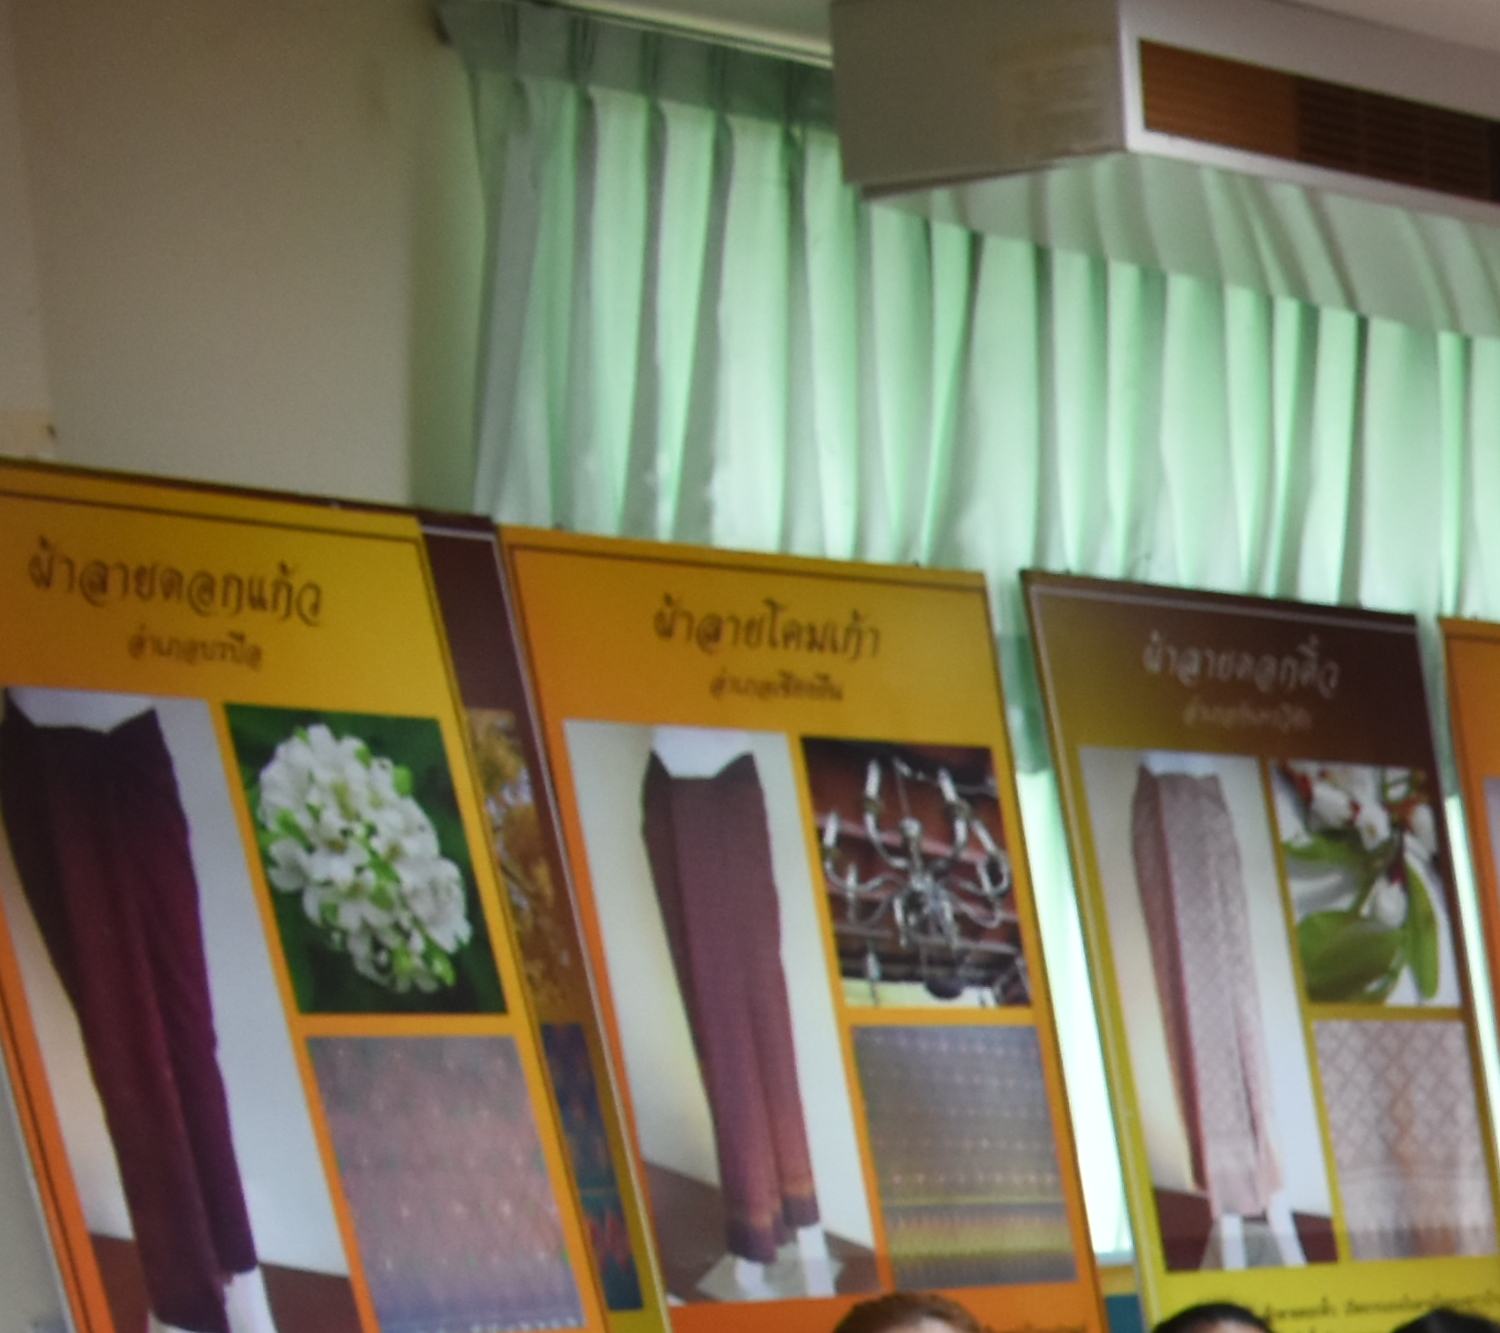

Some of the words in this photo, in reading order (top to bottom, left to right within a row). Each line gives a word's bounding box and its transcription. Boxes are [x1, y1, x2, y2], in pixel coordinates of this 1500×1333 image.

[28, 534, 324, 627] ผ้าลายดอกแก้ว
